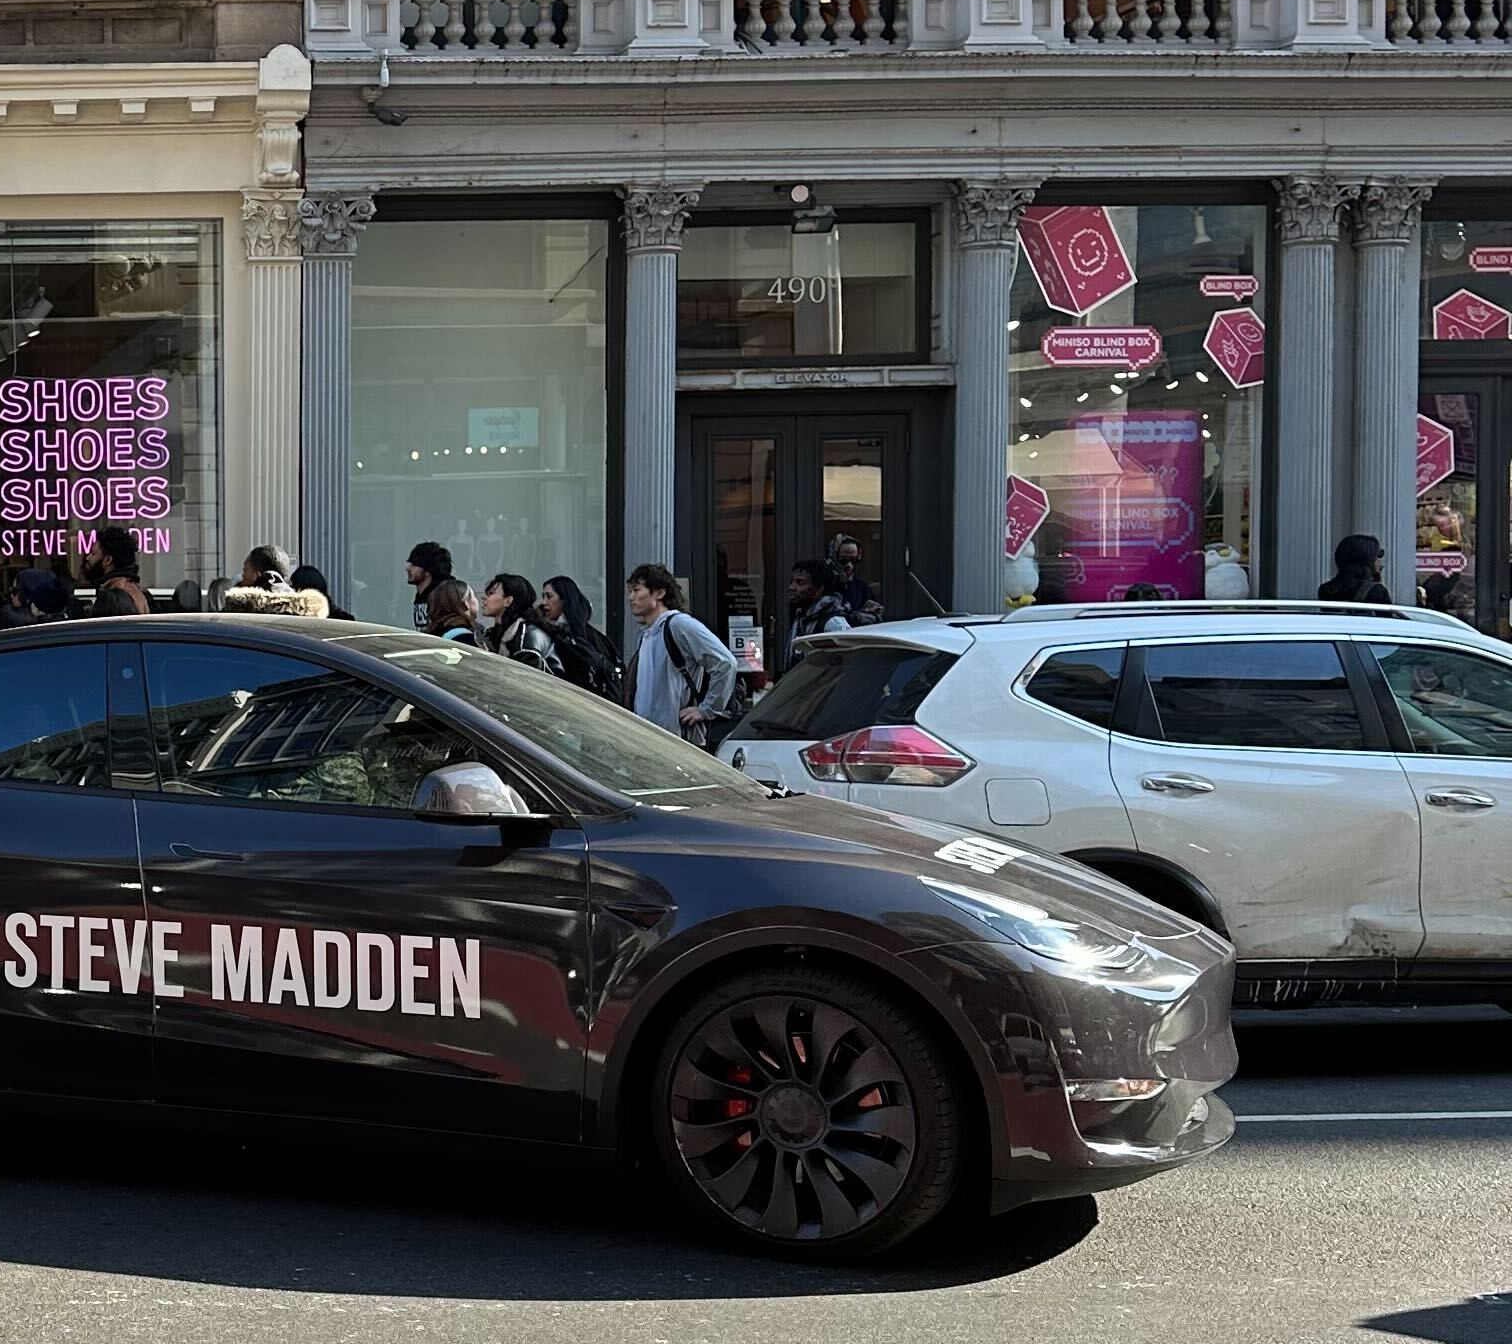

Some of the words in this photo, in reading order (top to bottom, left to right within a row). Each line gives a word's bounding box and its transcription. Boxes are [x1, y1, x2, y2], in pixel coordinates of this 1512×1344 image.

[768, 276, 826, 304] 490
[1233, 281, 1253, 290] BOX
[1052, 337, 1090, 347] MINISO
[1093, 337, 1126, 347] BLIND
[1128, 337, 1151, 347] BOX
[1074, 348, 1129, 358] CARNIVAL
[775, 373, 849, 385] ELEVATOR
[0, 378, 169, 423] SHOES
[0, 427, 170, 472] SHOES
[0, 476, 171, 521] SHOES
[1, 529, 67, 556] STEVE
[77, 527, 171, 554] MDEN
[735, 637, 745, 649] B
[4, 912, 185, 998] STEVE
[210, 923, 481, 1019] MADDEN
